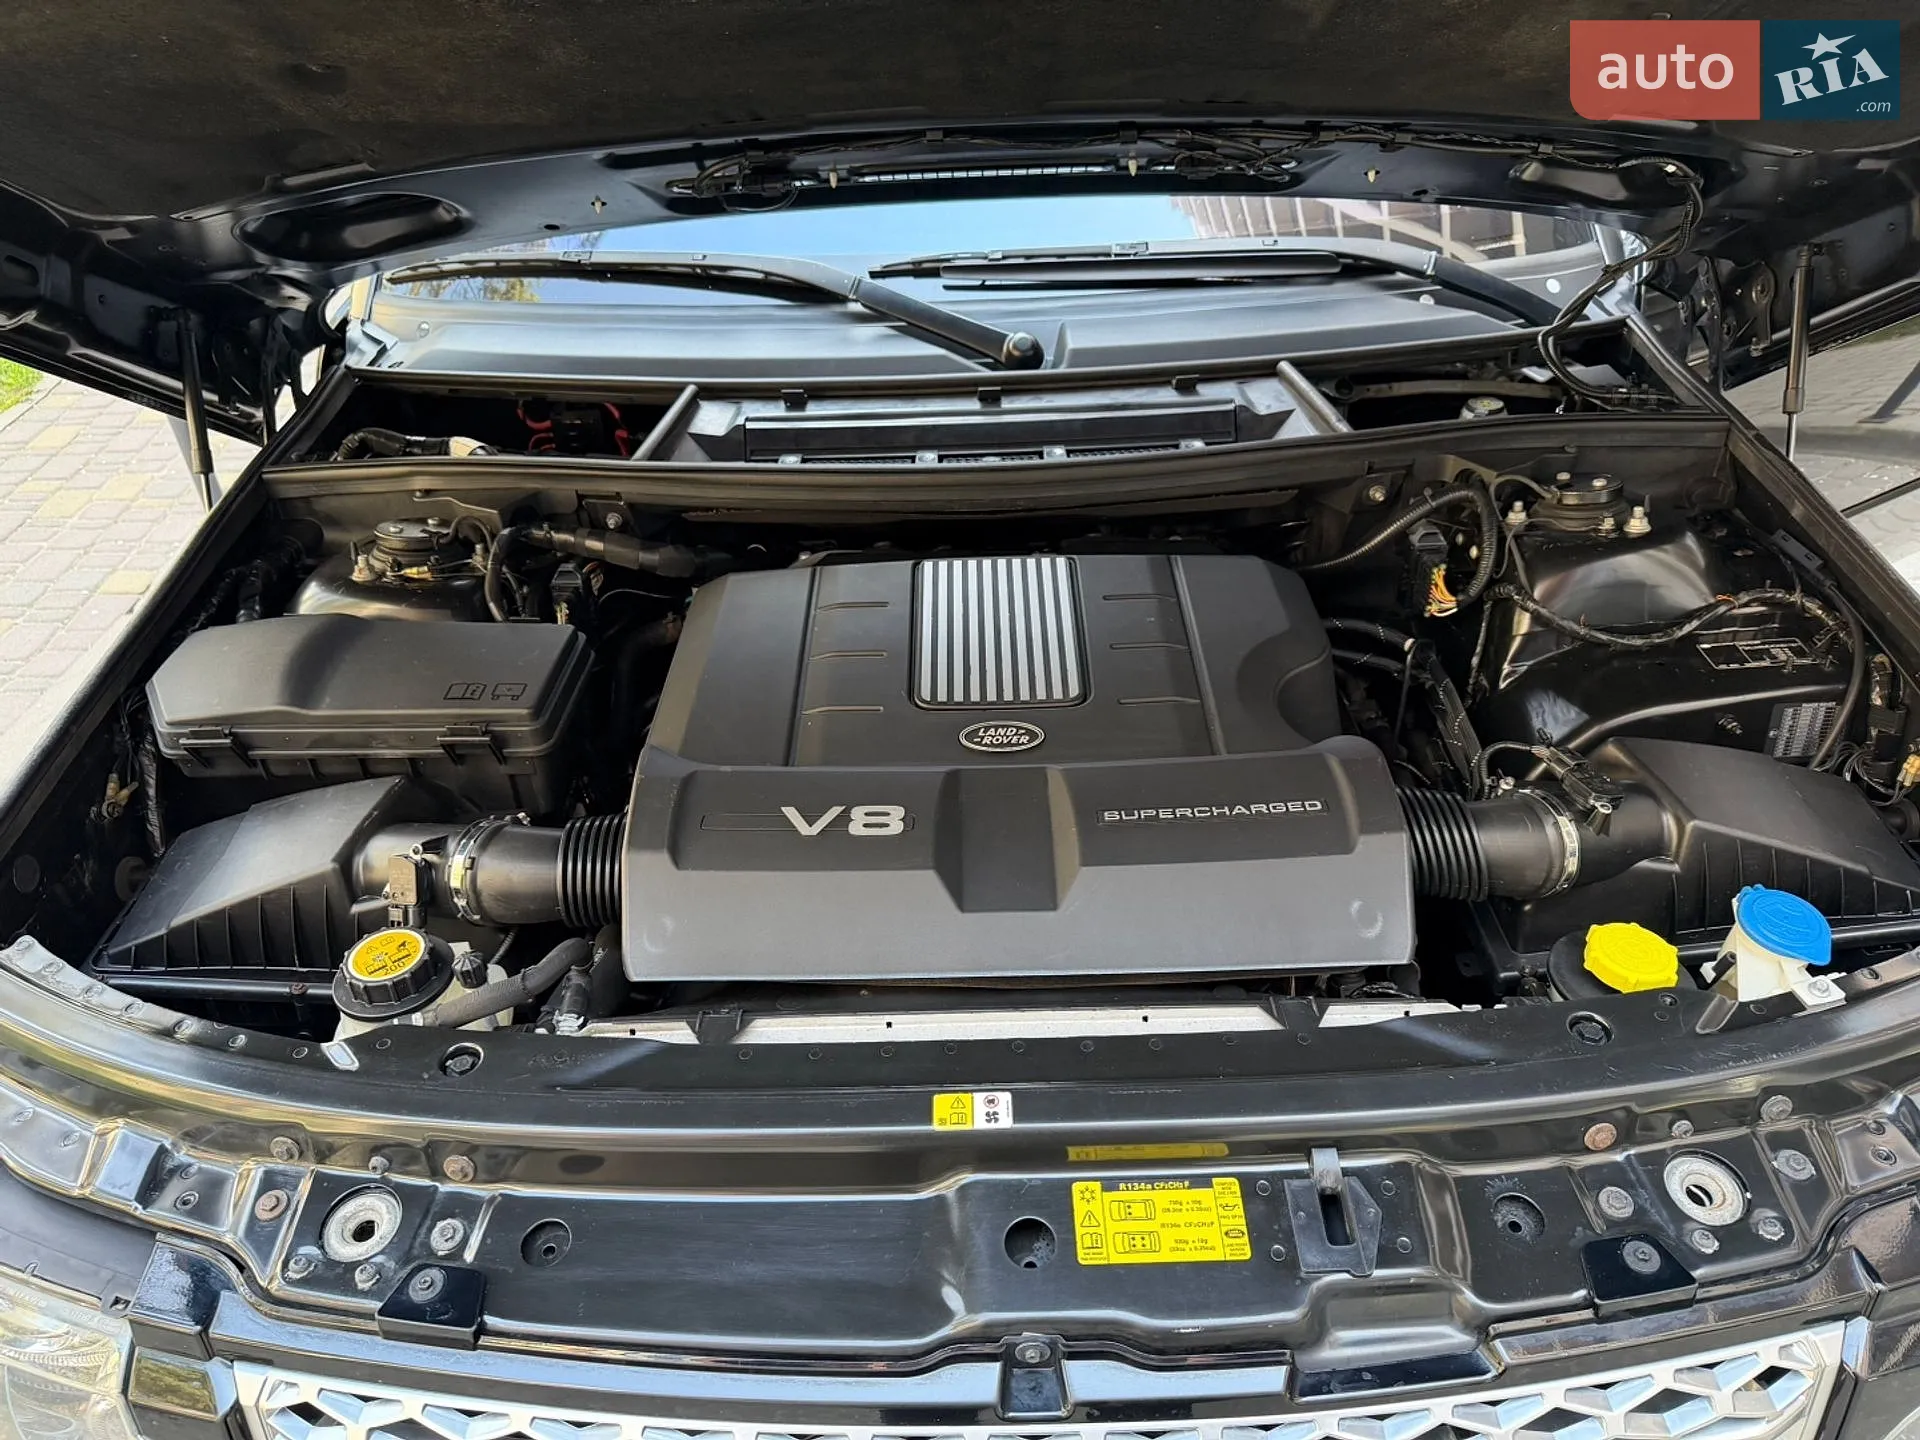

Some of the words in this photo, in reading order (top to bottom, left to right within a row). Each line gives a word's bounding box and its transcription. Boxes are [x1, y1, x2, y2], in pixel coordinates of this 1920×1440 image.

[978, 727, 1017, 736] LAND
[981, 735, 1030, 744] ROVER
[1104, 800, 1322, 821] SUPERCHARGED
[780, 805, 905, 836] V8
[1119, 1182, 1153, 1191] R134a
